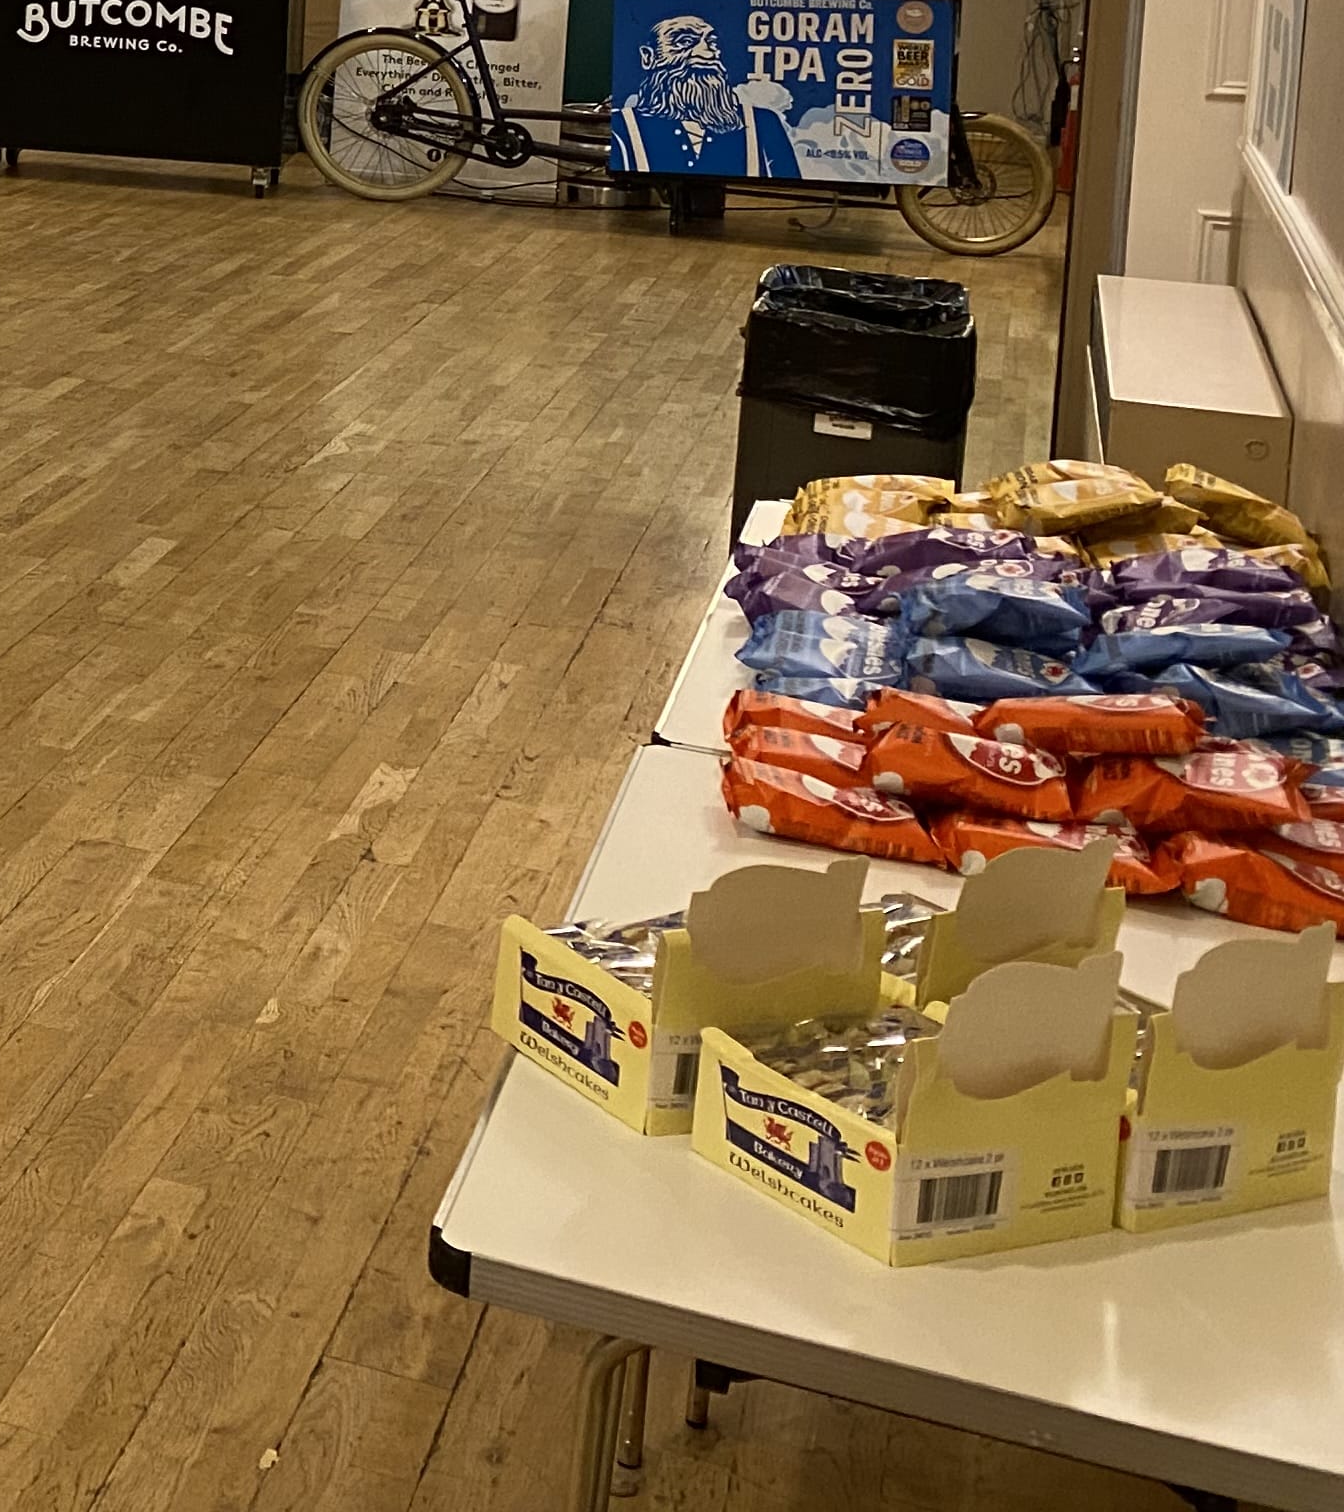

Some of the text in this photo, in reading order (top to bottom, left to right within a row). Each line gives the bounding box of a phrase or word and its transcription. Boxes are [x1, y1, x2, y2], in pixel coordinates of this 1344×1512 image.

[16, 0, 234, 55] BUTCOMBE
[748, 11, 874, 44] GORAM
[69, 35, 183, 53] BREWING Co.
[897, 51, 929, 61] BEER
[382, 54, 404, 65] The
[747, 45, 826, 83] IPA
[419, 86, 441, 97] and
[503, 76, 543, 90] Bitter,
[834, 48, 873, 138] ZERO
[896, 76, 930, 87] GOLD
[806, 148, 822, 158] ALC
[520, 1030, 609, 1101] Welshcakes
[778, 1100, 834, 1137] Castell
[730, 1151, 844, 1229] Welshcakes
